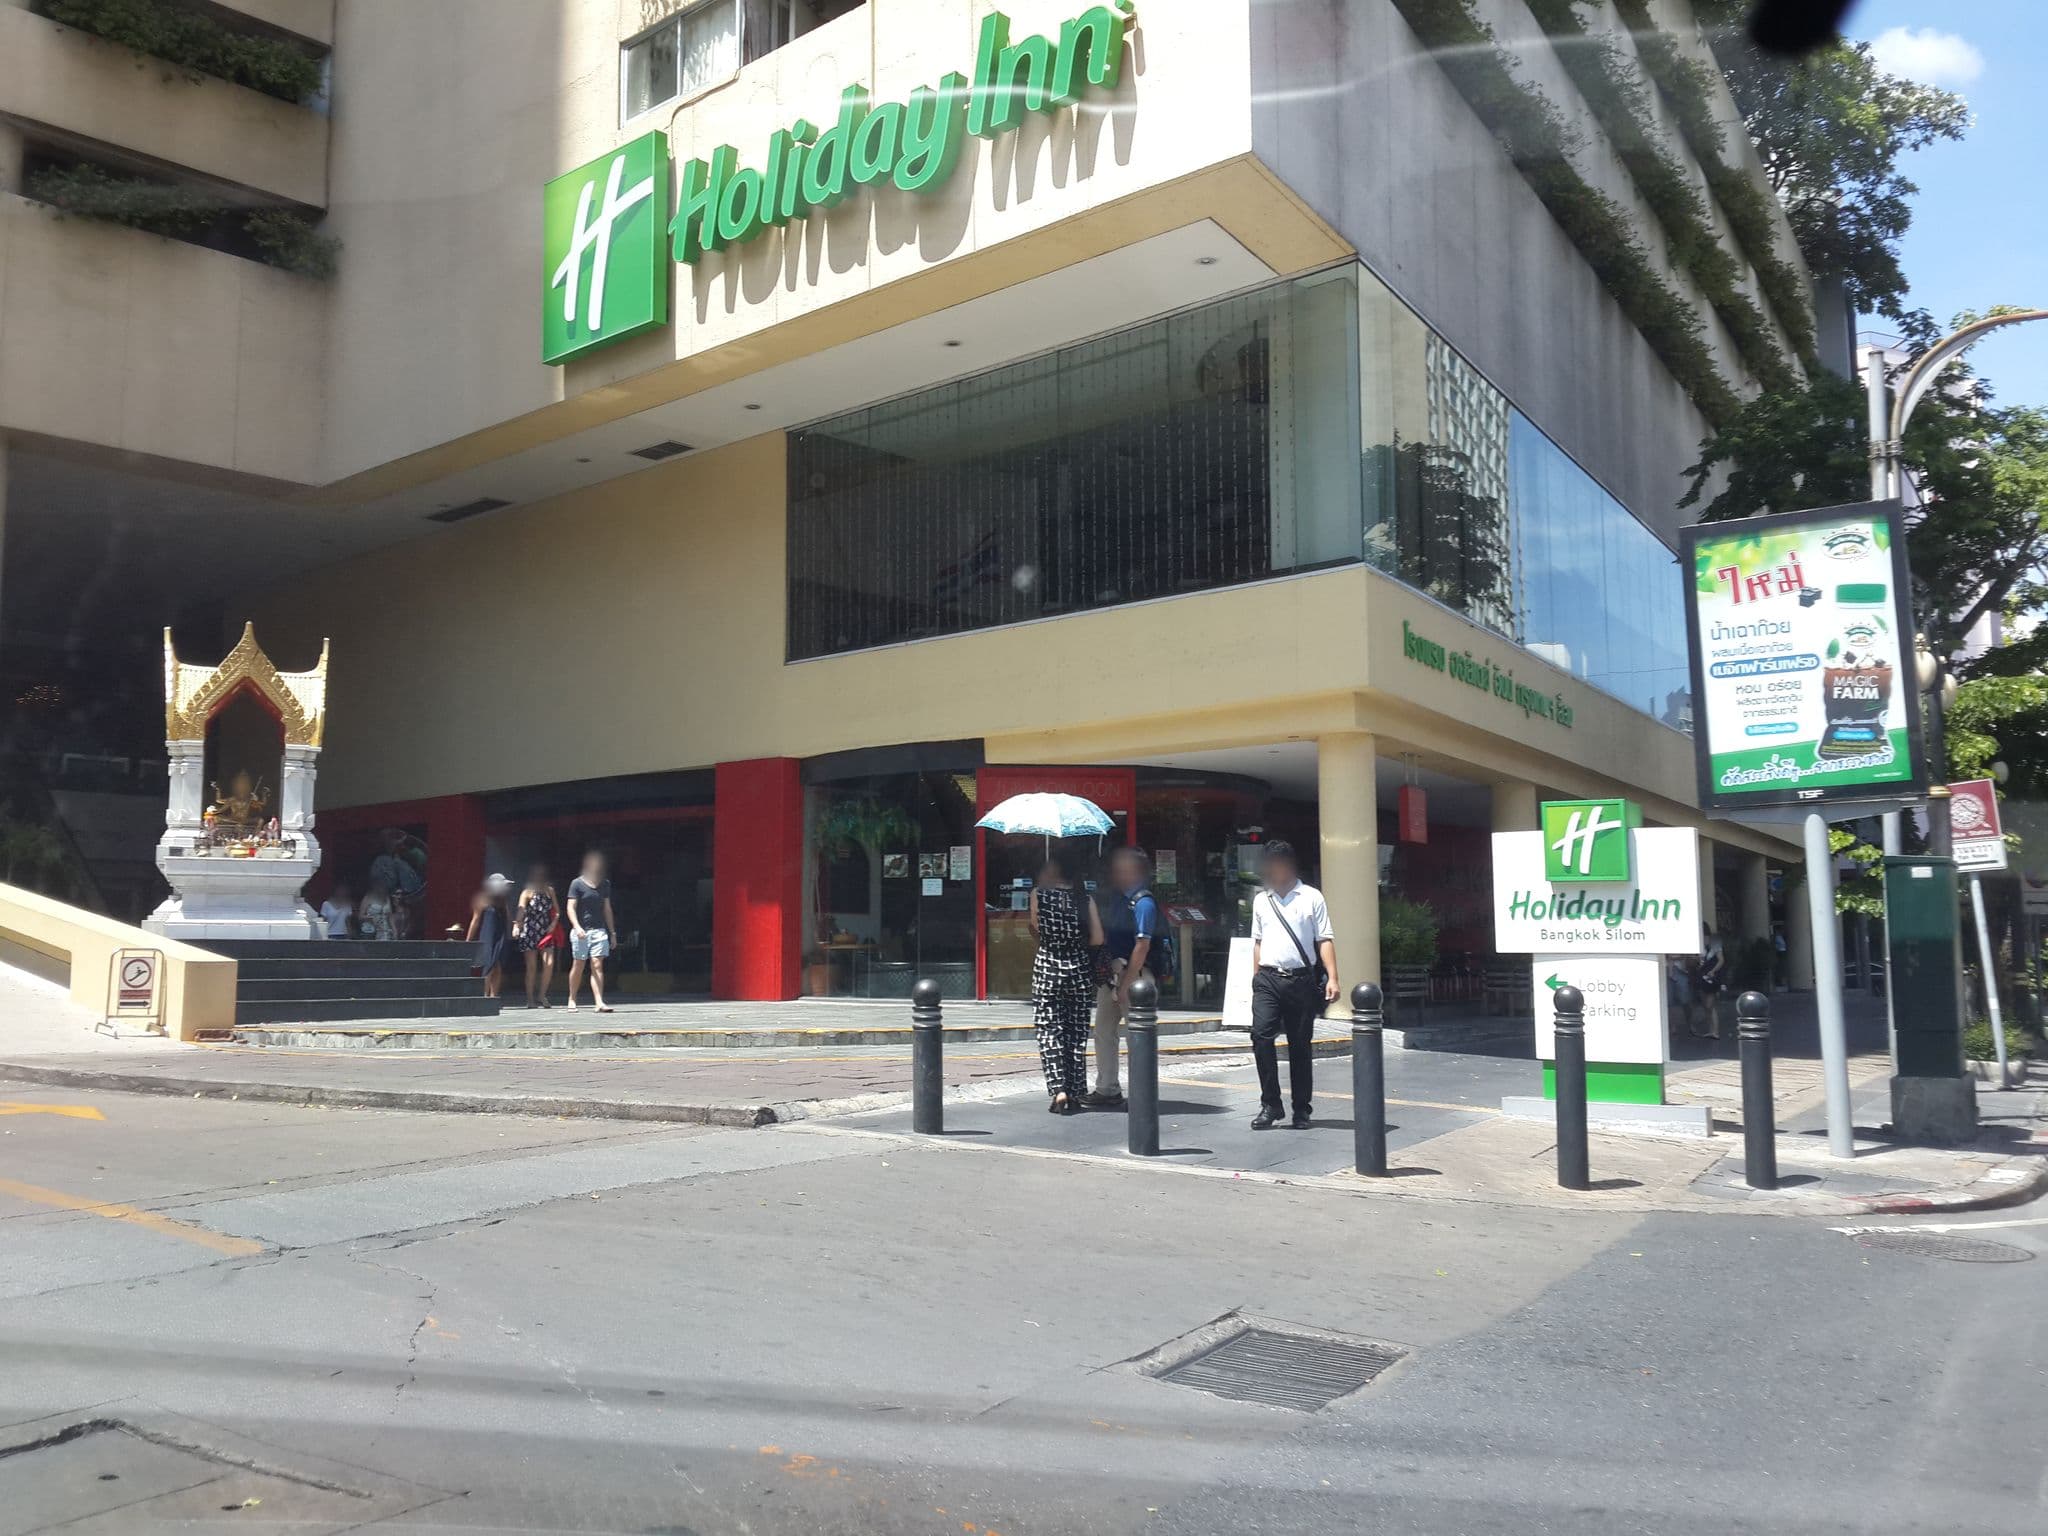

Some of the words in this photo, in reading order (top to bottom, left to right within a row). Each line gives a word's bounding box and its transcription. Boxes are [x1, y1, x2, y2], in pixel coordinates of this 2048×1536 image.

[668, 71, 968, 264] Holiday
[967, 5, 1126, 139] Inn
[1718, 551, 1808, 606] ใหม่
[1403, 619, 1445, 673] โรงแรม
[1833, 675, 1880, 687] MAGIC
[1833, 687, 1880, 699] FARM
[1797, 789, 1824, 800] TSF
[1509, 890, 1625, 928] Holiday
[1630, 889, 1681, 921] Inn
[1541, 929, 1600, 943] Bangkok
[1606, 929, 1646, 941] Silom
[1578, 979, 1626, 996] Lobby
